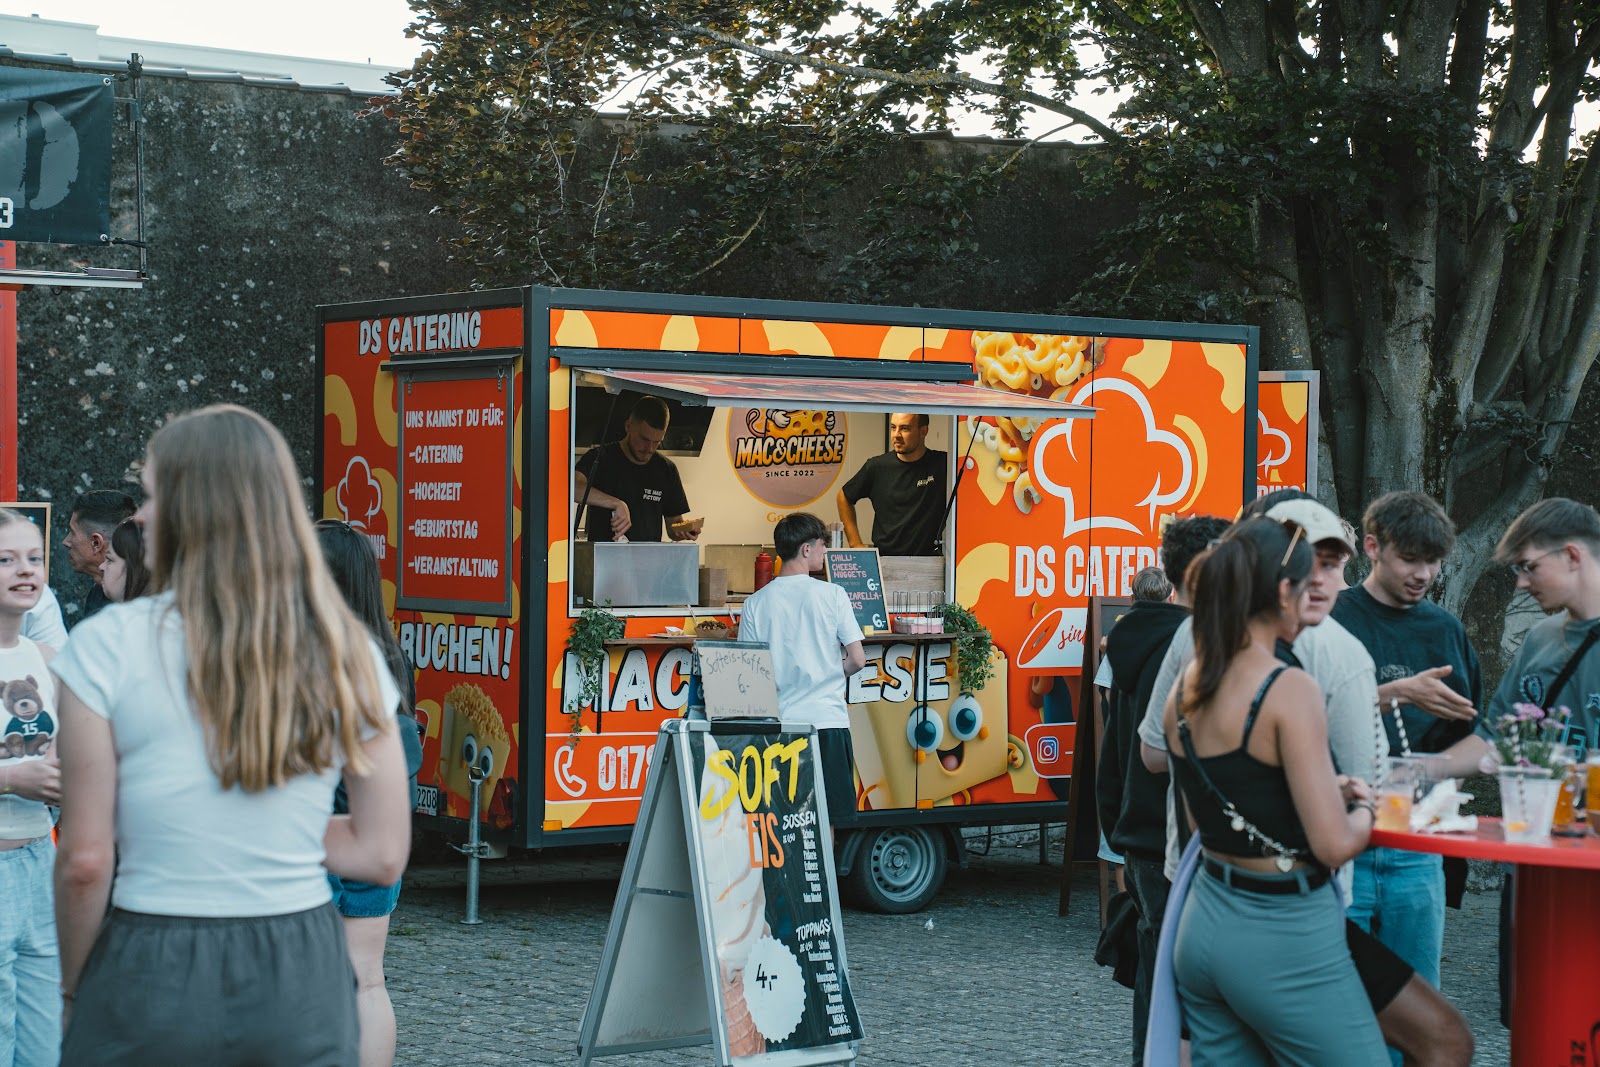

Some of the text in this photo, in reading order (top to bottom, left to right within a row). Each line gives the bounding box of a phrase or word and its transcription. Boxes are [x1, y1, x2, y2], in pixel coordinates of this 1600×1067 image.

[359, 311, 482, 355] DS CATERING
[405, 403, 504, 428] UNS KANNST DU FÜR:
[409, 445, 464, 464] -CATERING
[735, 433, 845, 469] MAC&CHEESE
[765, 469, 815, 478] SINCE 2022
[409, 482, 462, 501] -HOCHZEIT
[409, 519, 478, 539] -GEBURTSTAG
[408, 555, 499, 578] -VERANSTALTUNG
[830, 554, 856, 562] CHILLI-
[832, 563, 862, 571] CHEESE-
[1015, 545, 1056, 598] DS
[400, 622, 514, 680] BUCHEN!
[705, 651, 771, 680] Softeis-Kaffee
[561, 647, 693, 714] MAC
[22, 723, 38, 735] 15
[701, 738, 808, 820] SOFT
[782, 811, 816, 830] SOSSEN
[747, 812, 784, 868] EIS
[796, 918, 831, 941] TOPPINGS
[755, 963, 778, 991] 4,-
